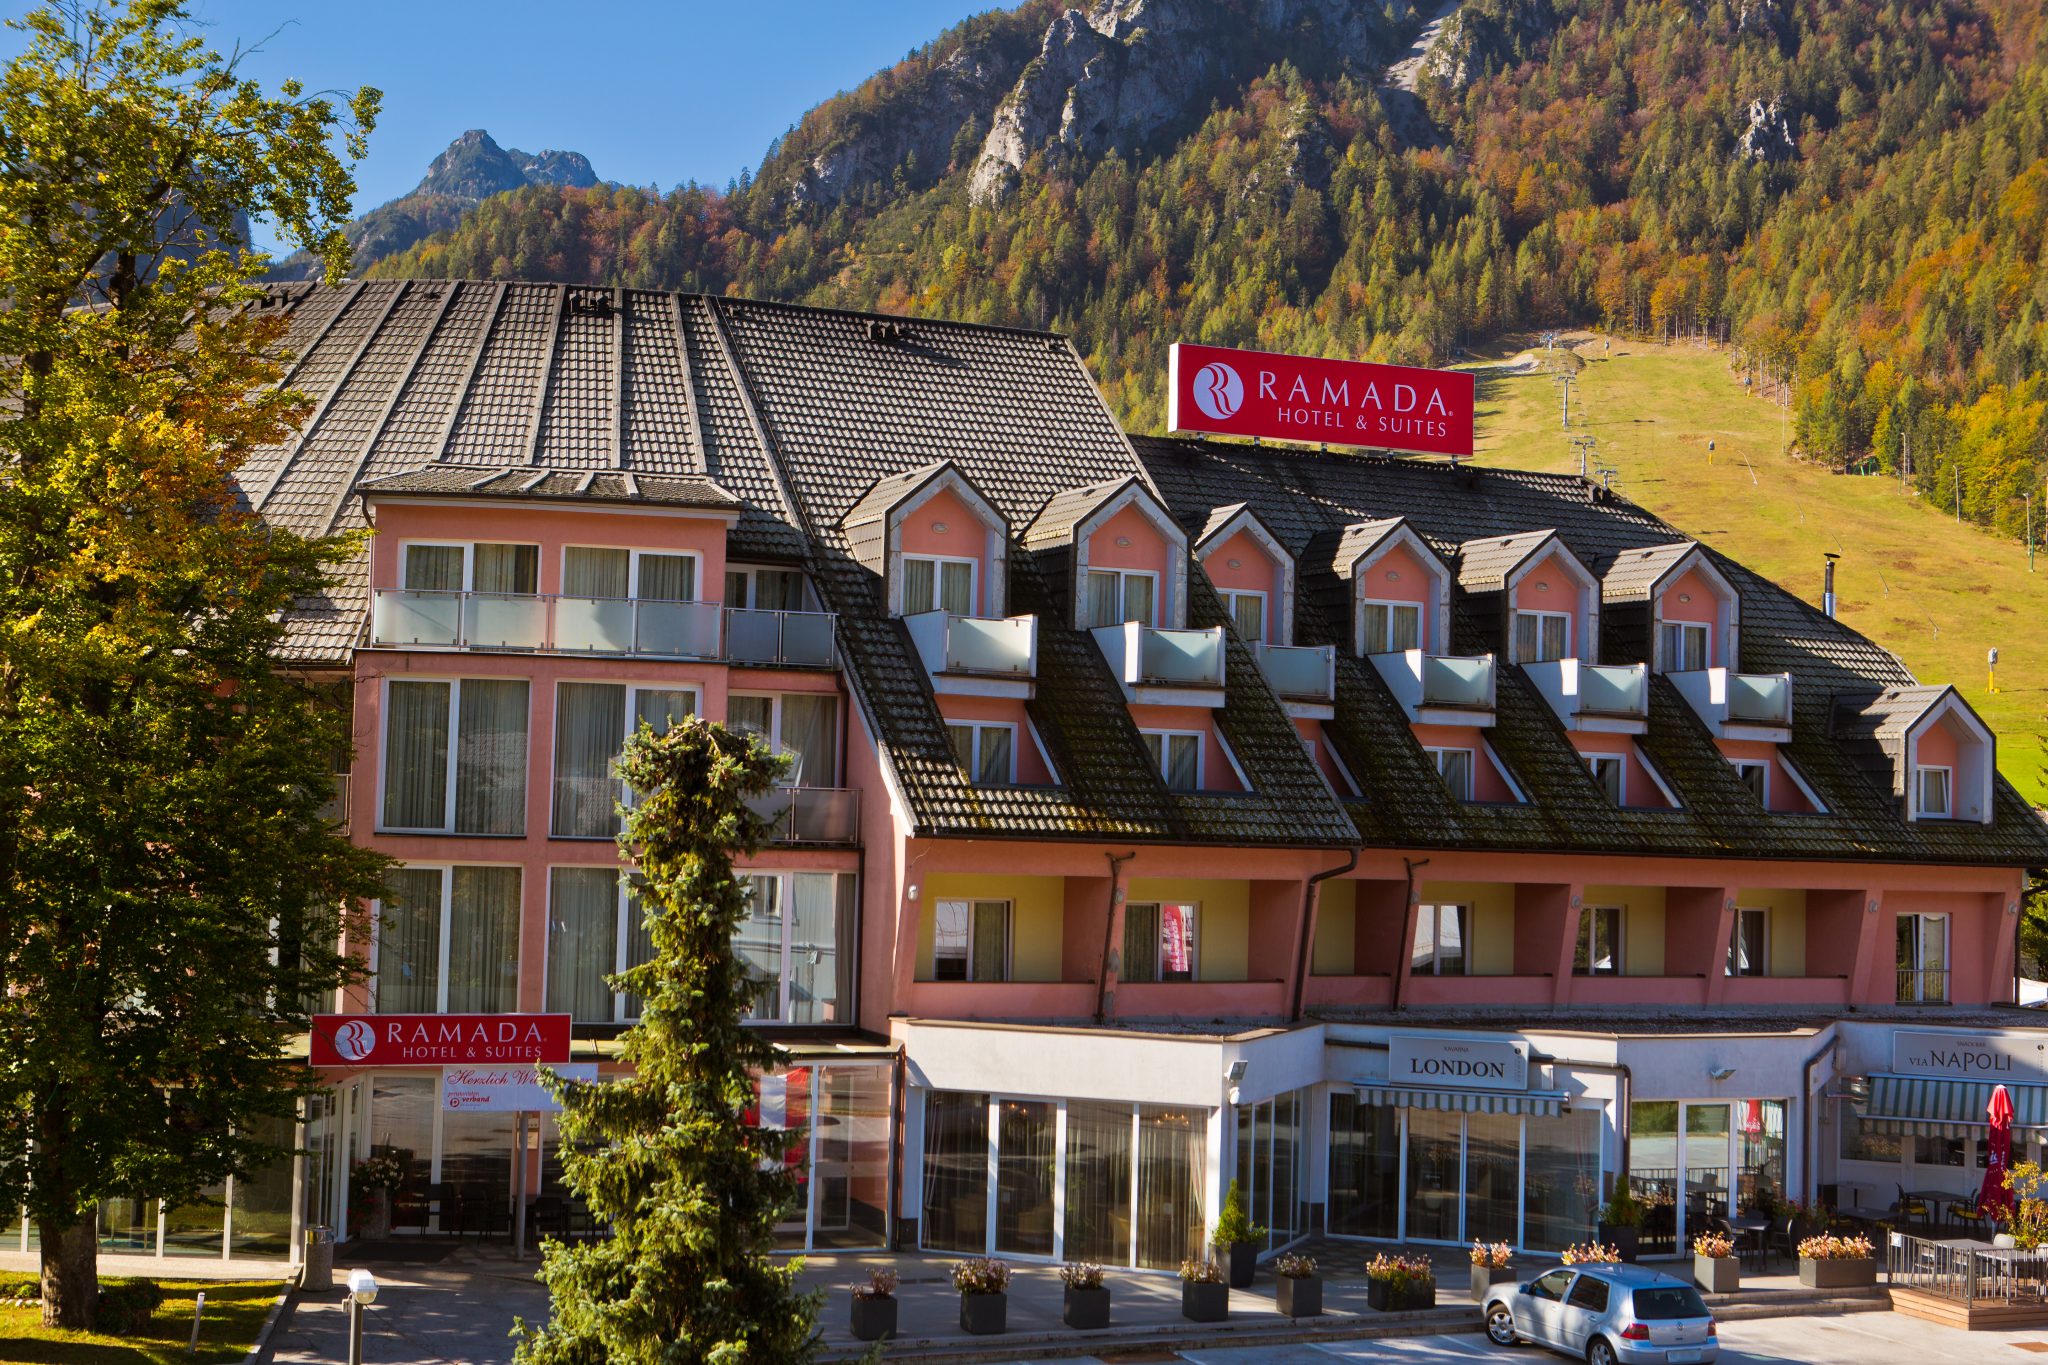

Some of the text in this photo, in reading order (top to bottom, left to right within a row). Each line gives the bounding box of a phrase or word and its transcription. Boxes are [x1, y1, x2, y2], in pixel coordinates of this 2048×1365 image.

[1259, 371, 1447, 416] RAMADA
[1278, 407, 1446, 437] HOTEL & SUITES
[388, 1022, 541, 1043] RAMADA
[403, 1046, 541, 1058] HOTEL & SUITES
[1909, 1050, 2012, 1071] VIA NAPOLI
[447, 1069, 509, 1085] Herzlich
[1410, 1058, 1505, 1079] LONDON
